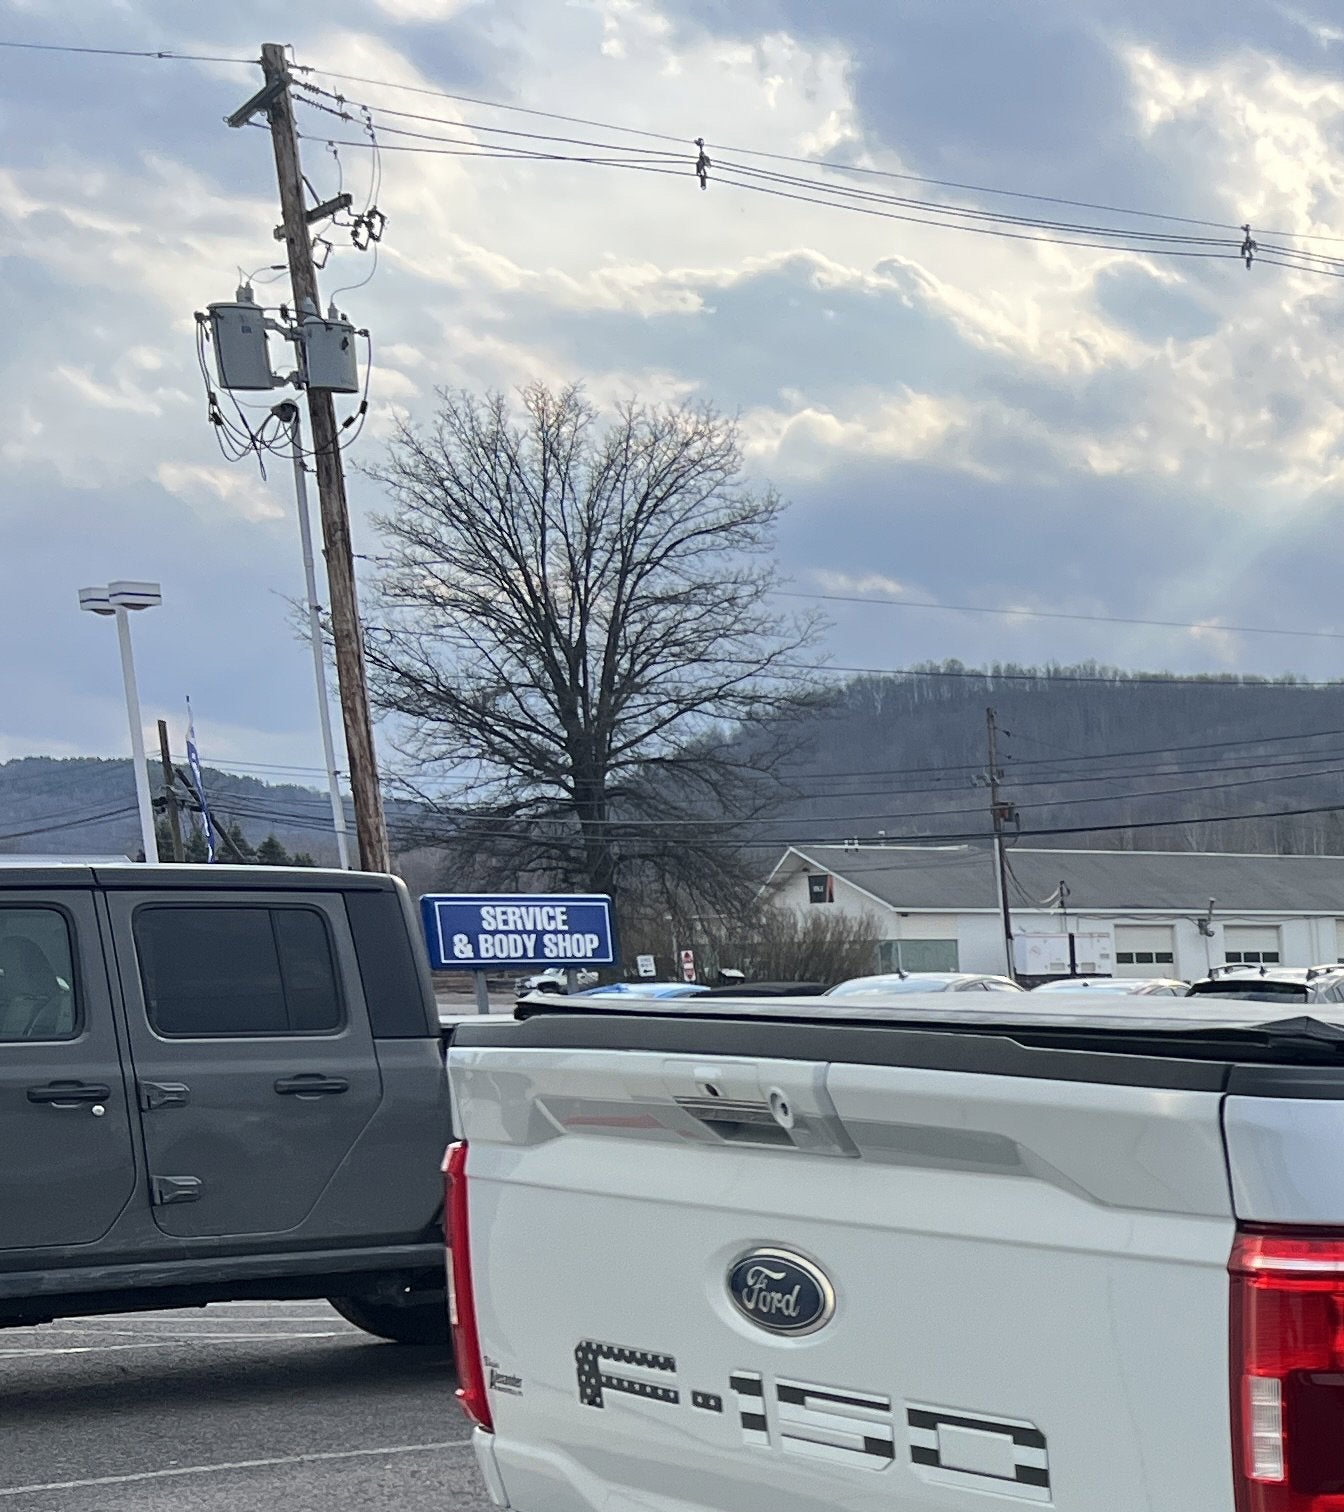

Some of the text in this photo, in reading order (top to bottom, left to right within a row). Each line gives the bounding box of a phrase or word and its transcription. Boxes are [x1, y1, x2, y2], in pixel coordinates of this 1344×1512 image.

[480, 906, 569, 931] SERVICE
[453, 933, 600, 958] & BODY SHOP
[741, 1265, 801, 1317] Ford
[574, 1338, 1053, 1506] F-150
